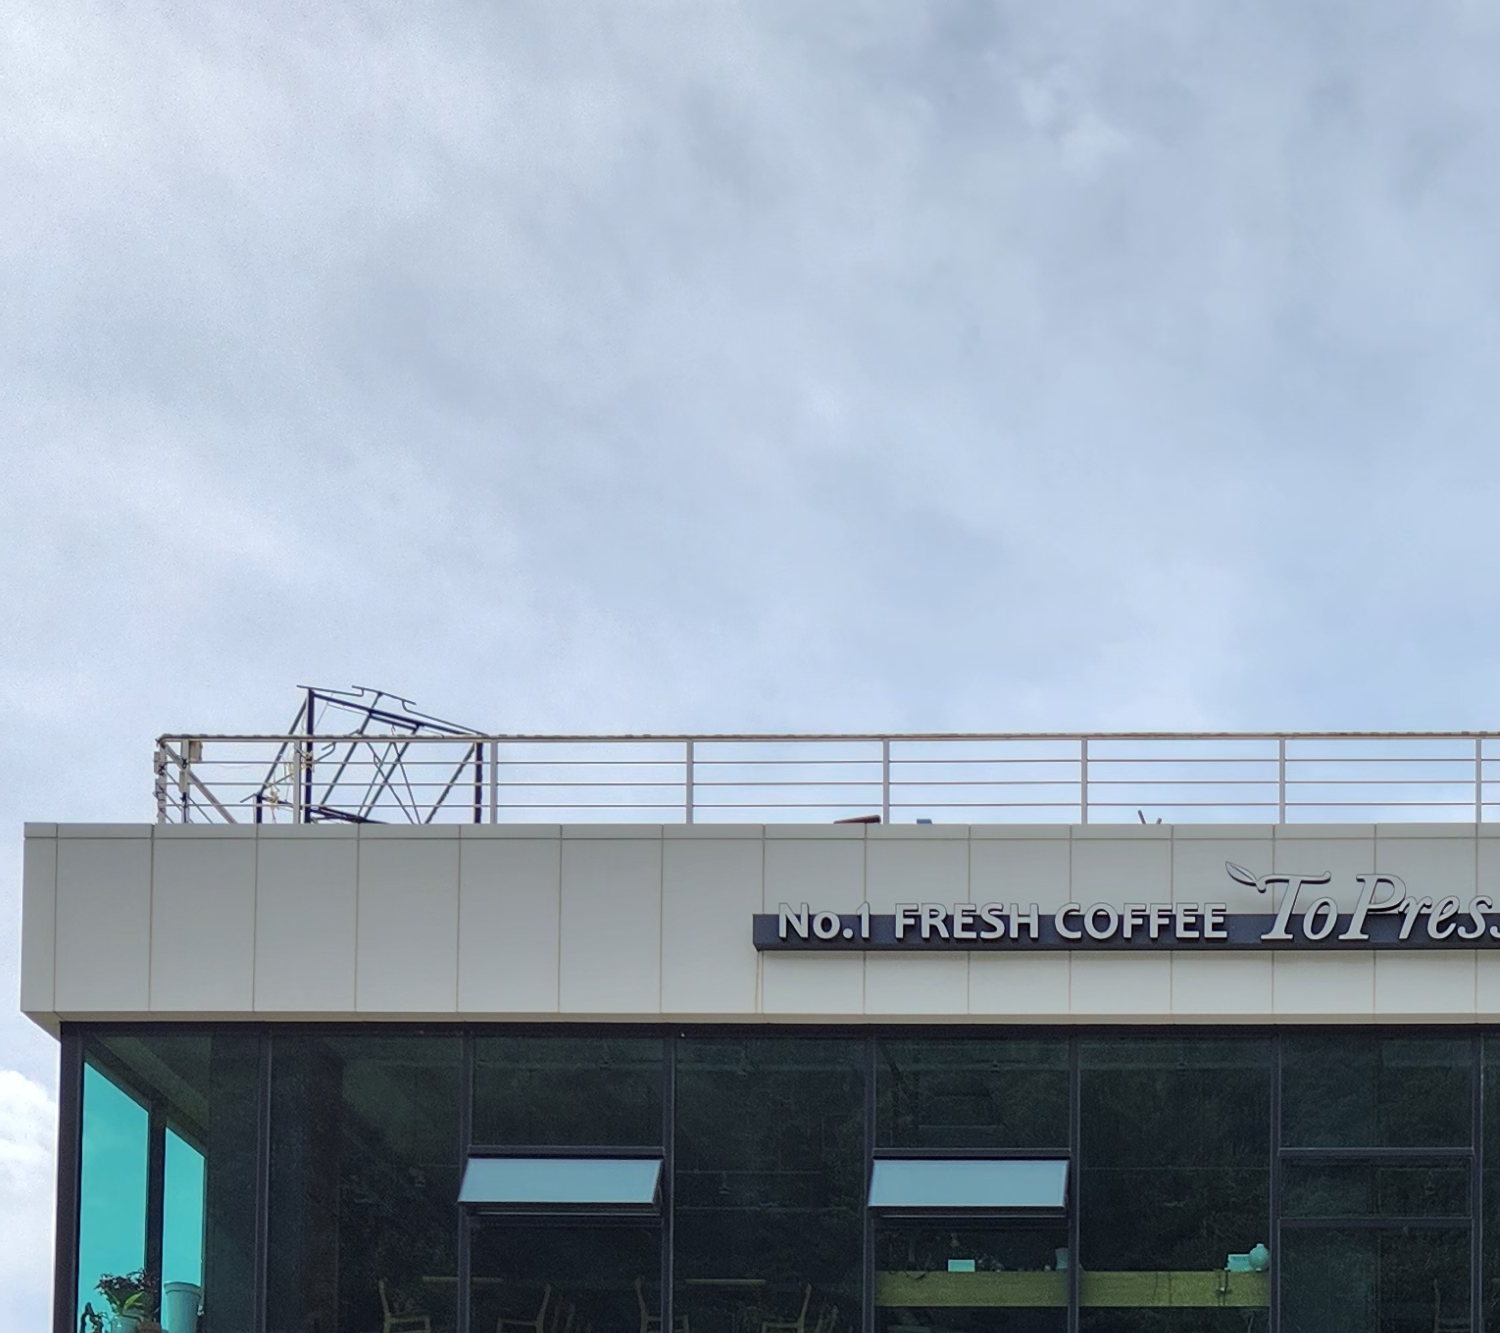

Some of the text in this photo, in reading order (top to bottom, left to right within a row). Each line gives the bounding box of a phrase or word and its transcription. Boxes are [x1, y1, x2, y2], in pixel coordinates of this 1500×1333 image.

[776, 902, 871, 942] No.1
[893, 901, 1041, 942] FRESH
[1054, 901, 1230, 942] COFFEE
